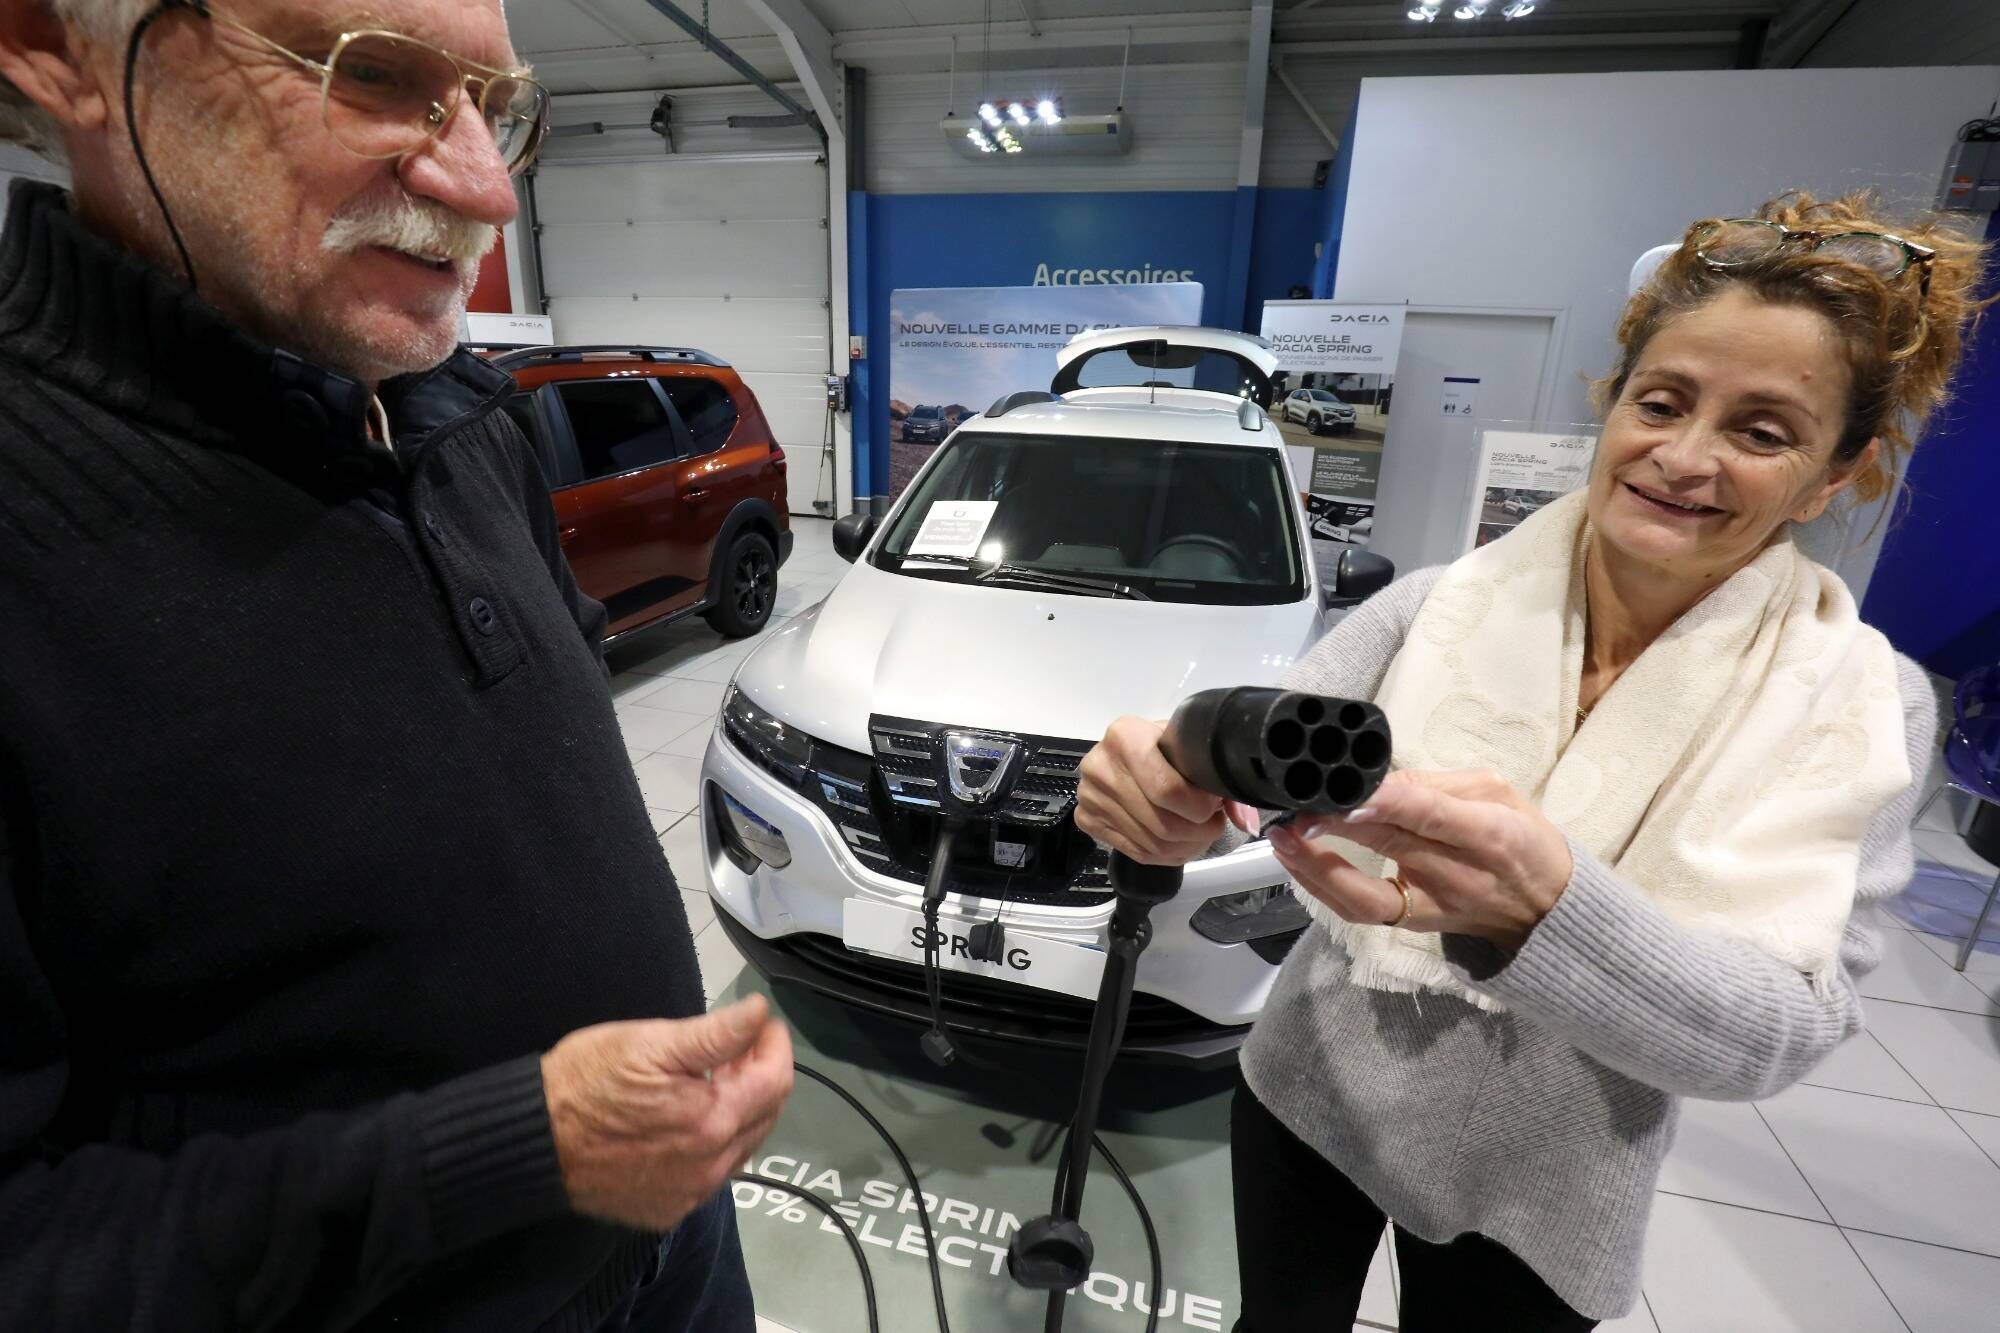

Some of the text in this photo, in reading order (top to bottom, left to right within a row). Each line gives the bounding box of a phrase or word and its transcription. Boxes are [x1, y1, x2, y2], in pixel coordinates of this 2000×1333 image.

[1033, 263, 1194, 287] Accessoires
[1330, 314, 1390, 323] DACIA
[900, 323, 990, 335] NOUVELLE
[993, 323, 1061, 335] GAMME
[1272, 334, 1351, 344] NOUVELLE
[1273, 343, 1373, 354] DACIA SPRING
[910, 926, 1032, 971] SPRG
[860, 1180, 1022, 1239] SPRIN
[819, 1199, 1222, 1332] ÉLECTQUE
